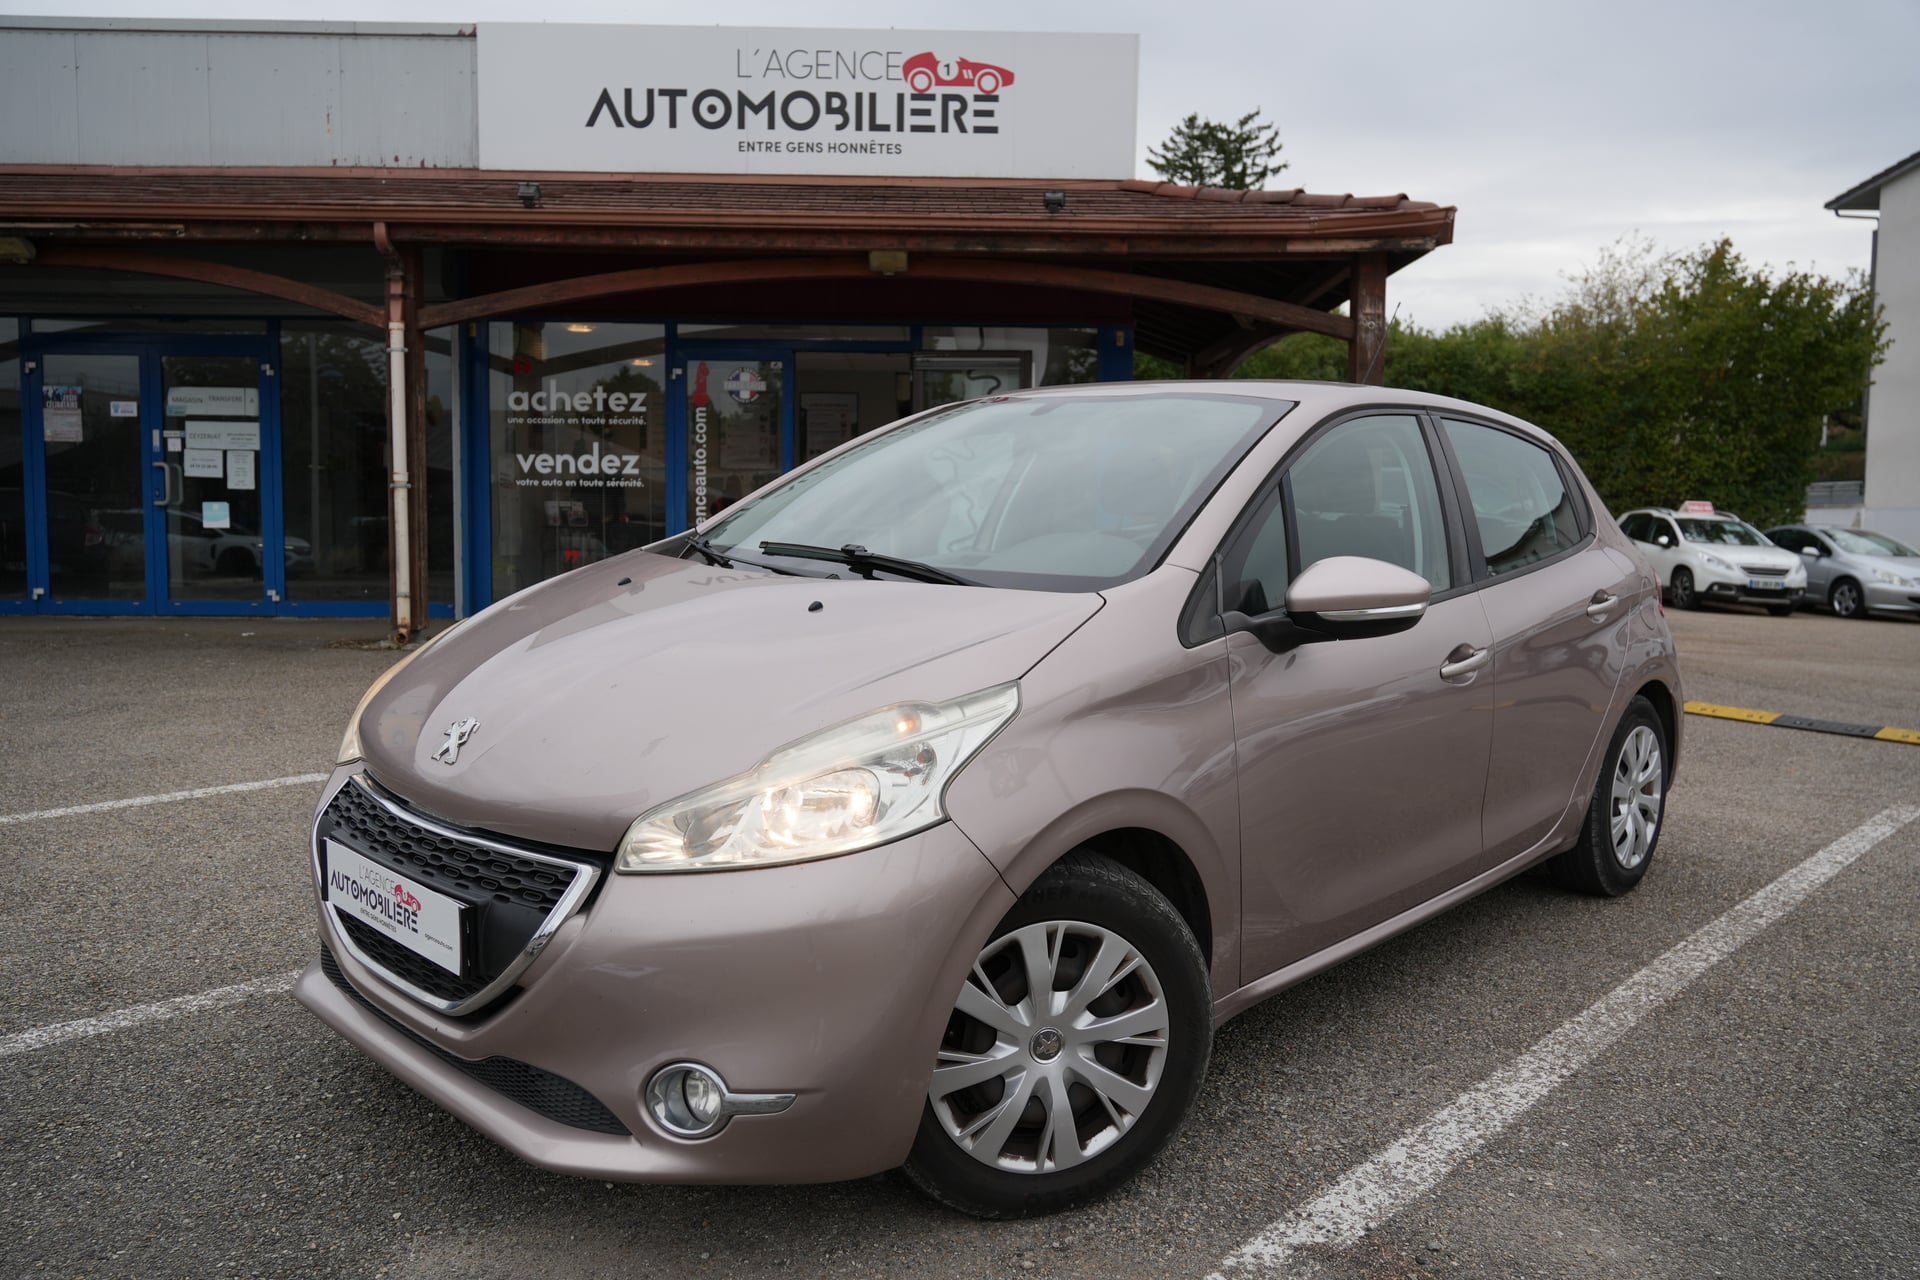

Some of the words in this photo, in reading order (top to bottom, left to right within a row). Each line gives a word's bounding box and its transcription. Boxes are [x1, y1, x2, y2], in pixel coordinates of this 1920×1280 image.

[943, 62, 950, 76] 1
[738, 140, 782, 153] ENTRE
[786, 141, 824, 154] GENS
[828, 139, 902, 155] HONNÊTES
[507, 379, 647, 412] achetez
[526, 415, 565, 424] occasion
[581, 416, 606, 425] toute
[608, 415, 647, 425] sécurité.
[516, 441, 640, 475] vendez
[515, 478, 539, 487] votre
[541, 478, 563, 487] auto
[579, 478, 605, 487] toute
[606, 477, 645, 488] sérénité.
